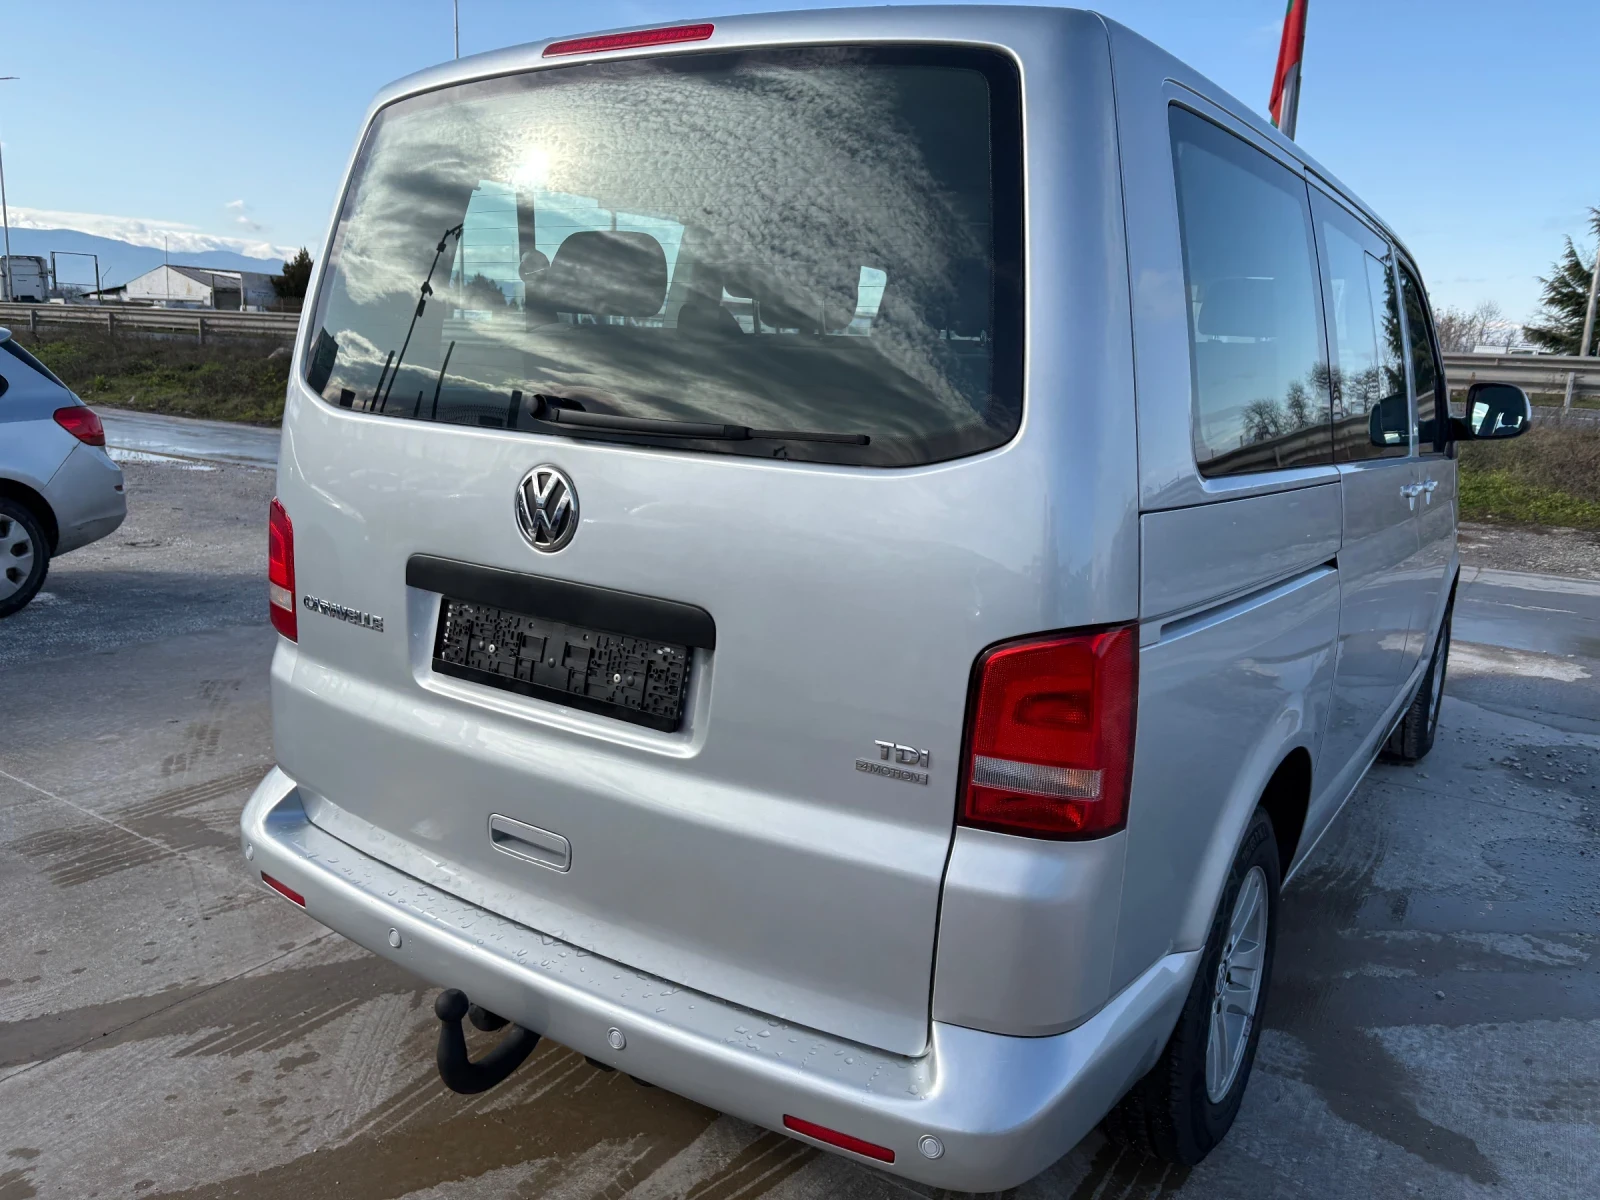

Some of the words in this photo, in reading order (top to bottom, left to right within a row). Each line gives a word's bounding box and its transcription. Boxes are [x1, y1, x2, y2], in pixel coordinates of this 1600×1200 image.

[516, 466, 575, 548] VW
[303, 594, 384, 633] CARAVELLE
[874, 739, 929, 768] TDI
